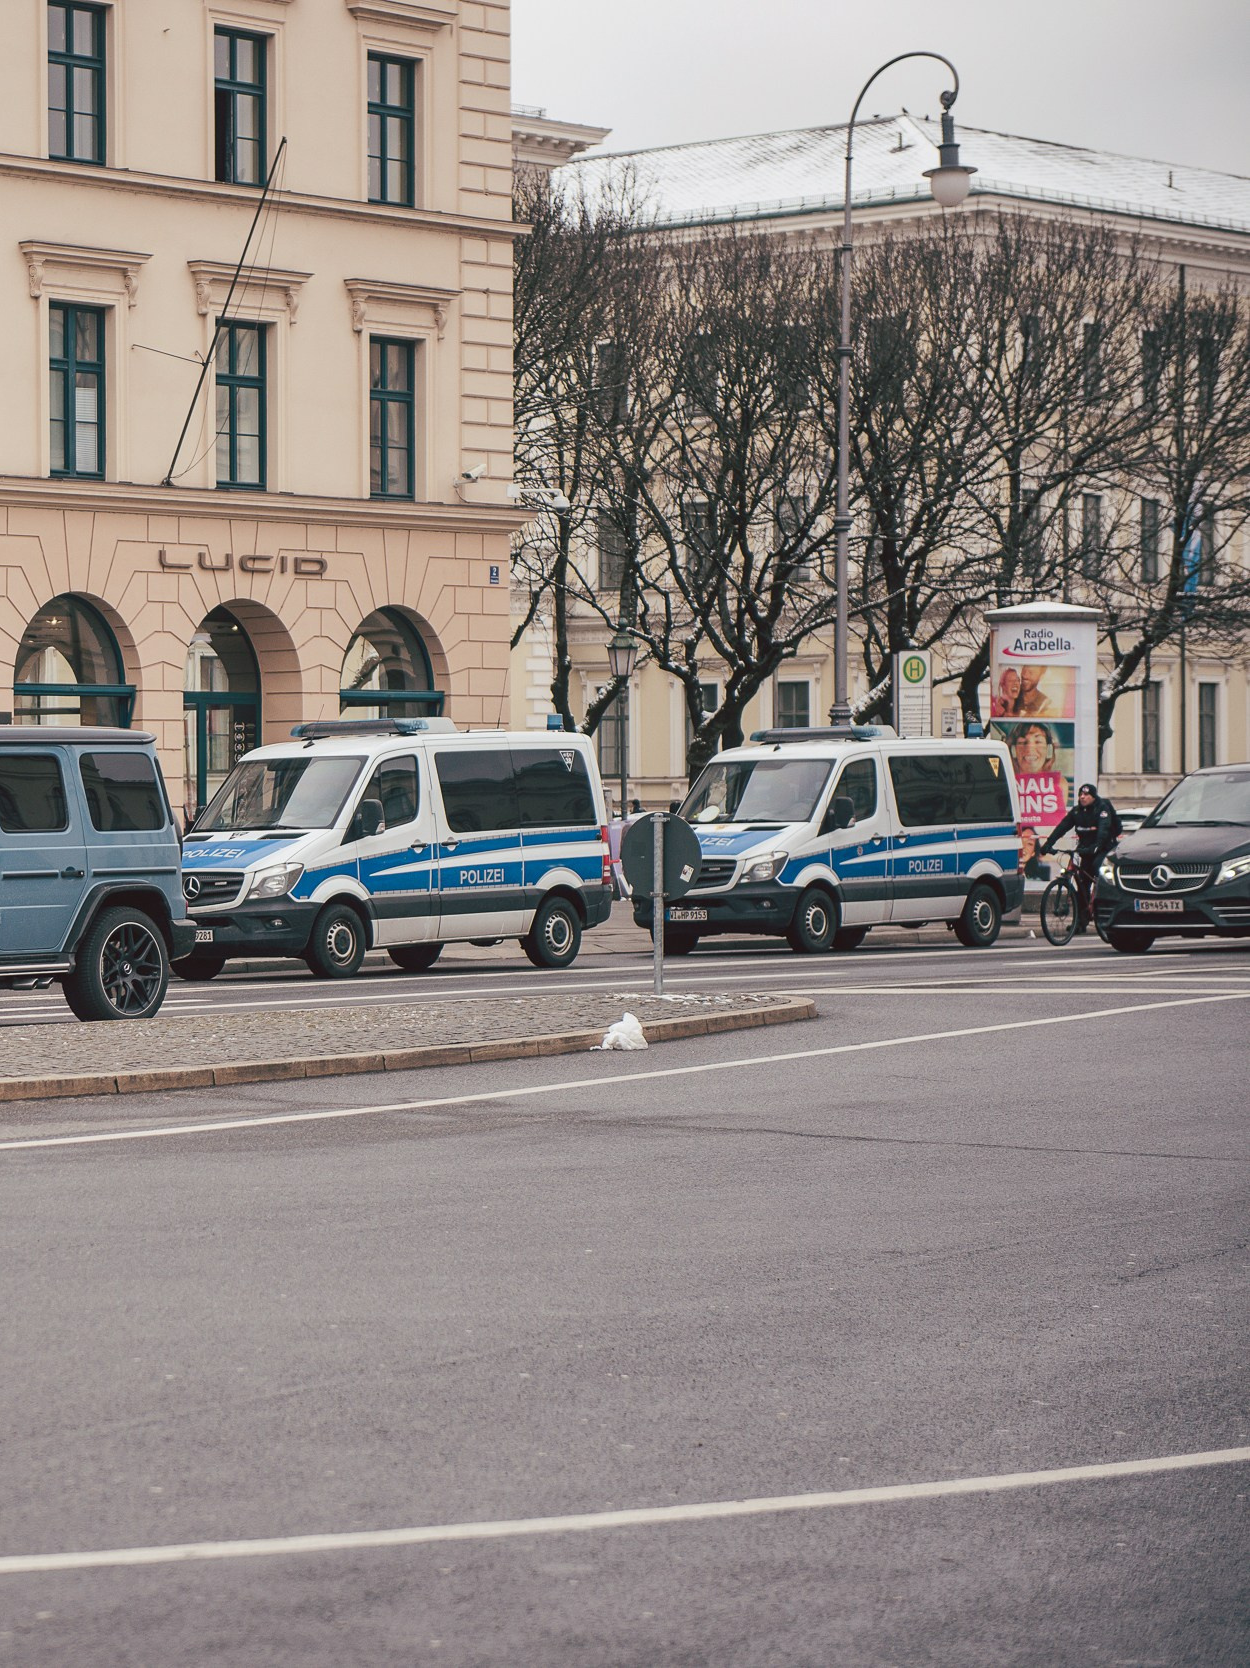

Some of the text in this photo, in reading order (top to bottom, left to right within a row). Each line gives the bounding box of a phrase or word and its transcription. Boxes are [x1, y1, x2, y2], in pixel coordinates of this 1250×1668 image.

[159, 549, 328, 575] LUCID
[1023, 628, 1054, 639] Radio
[910, 661, 920, 677] H
[182, 848, 246, 859] POLIZEI
[908, 859, 944, 873] POLIZEI
[459, 868, 505, 885] POLIZEI
[690, 911, 707, 920] 9153
